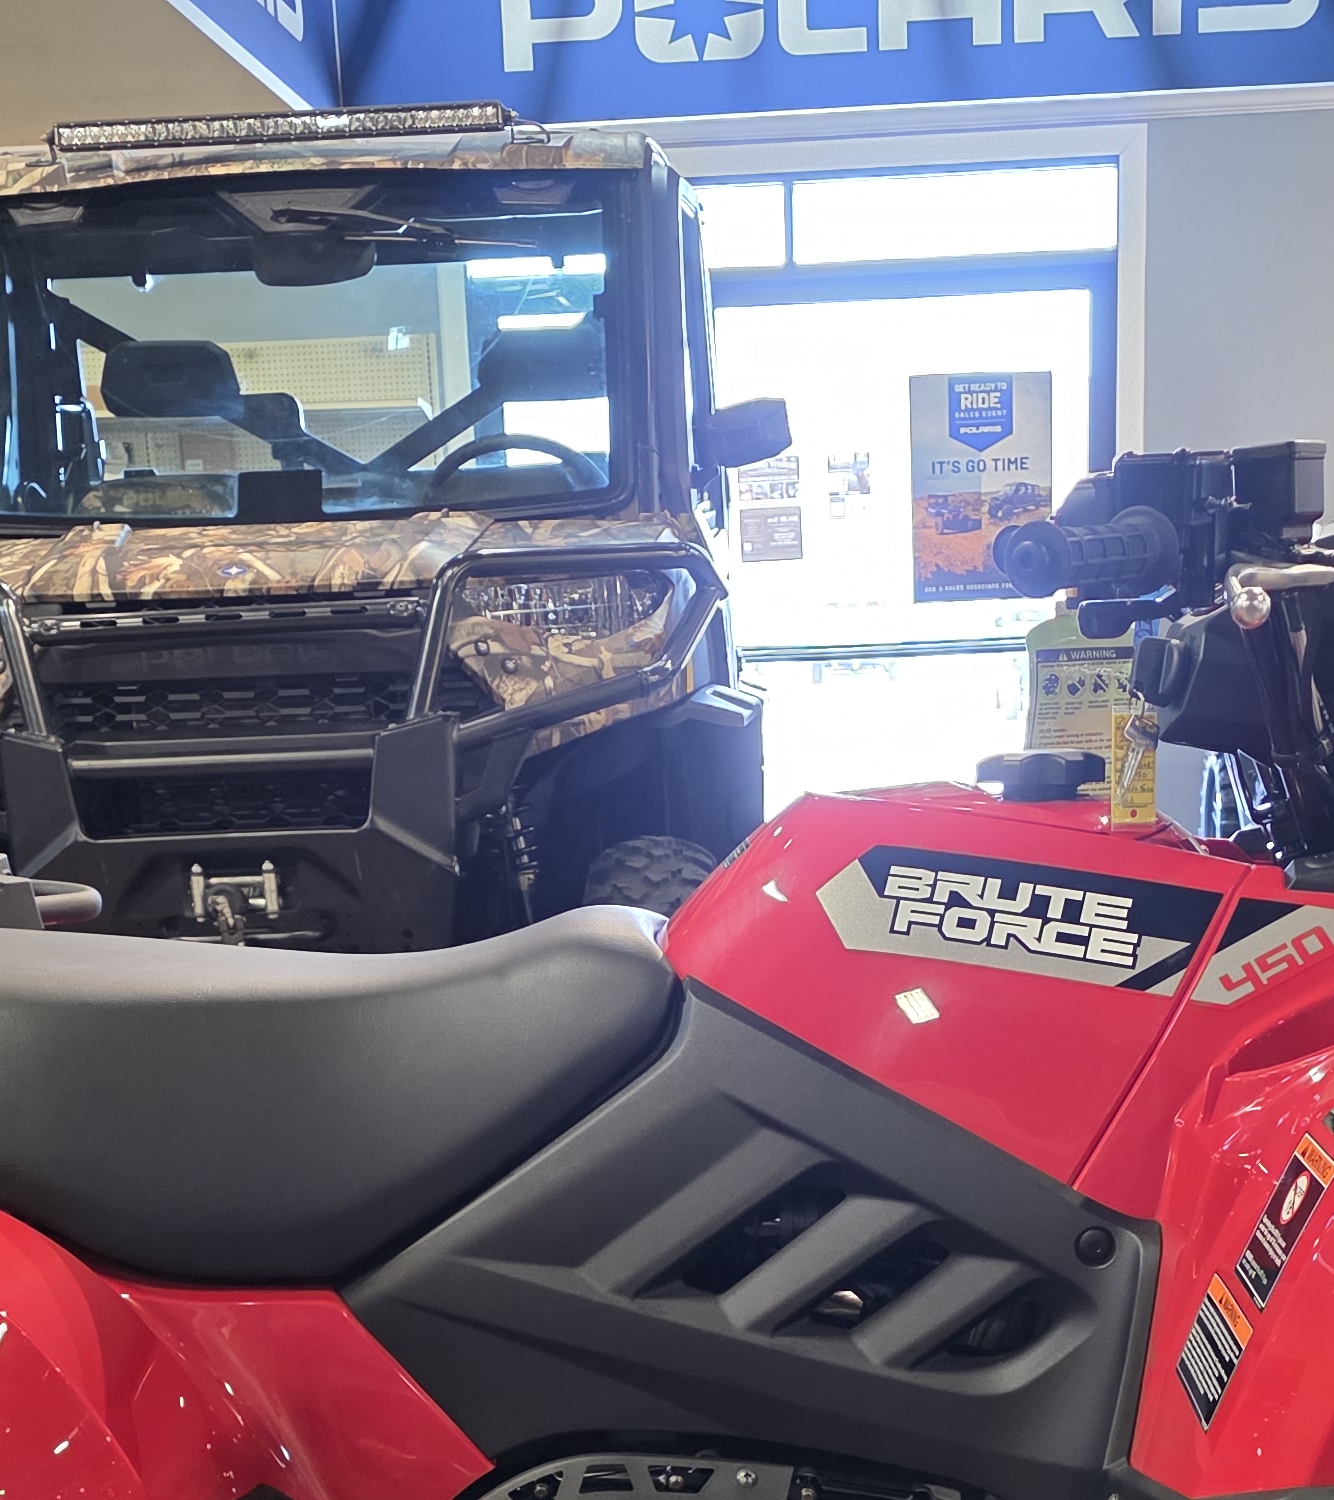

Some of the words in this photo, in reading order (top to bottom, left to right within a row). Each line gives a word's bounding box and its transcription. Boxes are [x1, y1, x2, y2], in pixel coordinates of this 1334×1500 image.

[954, 384, 969, 392] GET
[970, 383, 995, 392] READY
[997, 382, 1007, 390] TO
[960, 392, 1002, 410] RIDE
[960, 426, 1002, 434] POLARIS
[931, 460, 961, 475] IT'S
[966, 459, 987, 473] GO
[991, 457, 1029, 472] TIME
[1070, 649, 1116, 660] WARNING
[884, 865, 1134, 930] BRUTE
[893, 899, 1139, 967] FORCE
